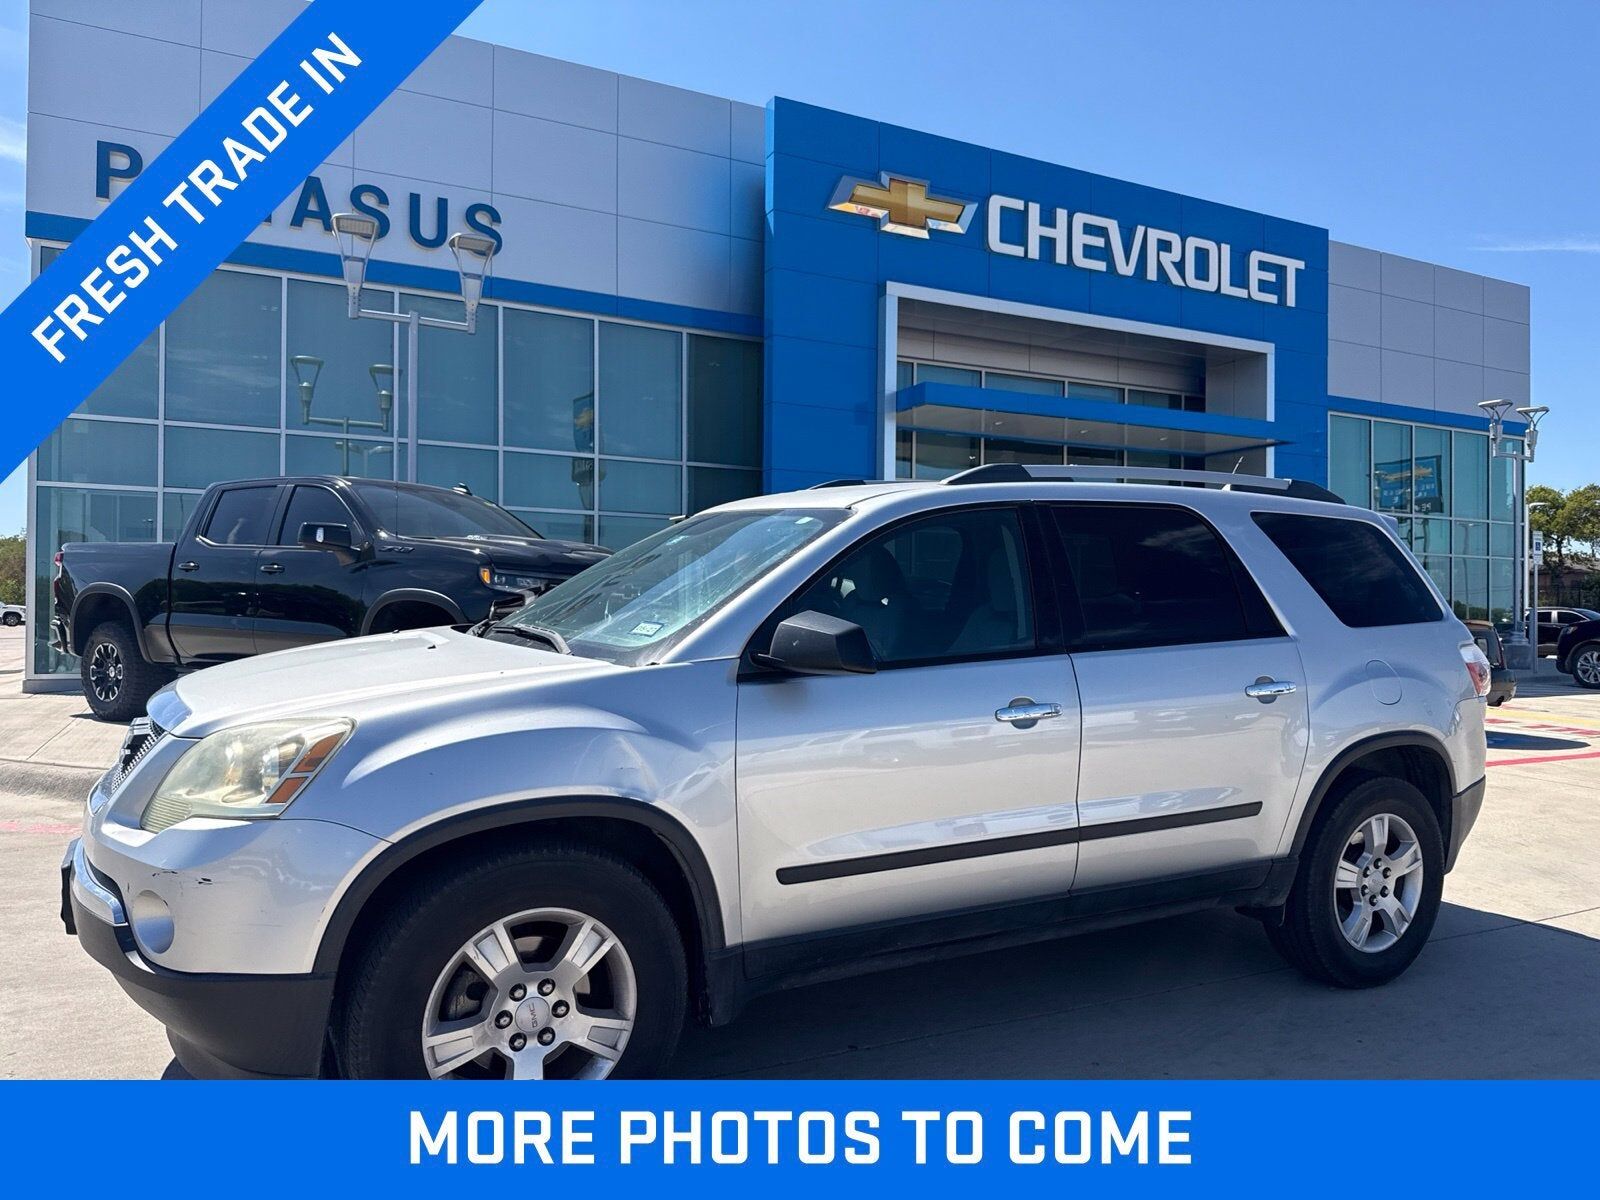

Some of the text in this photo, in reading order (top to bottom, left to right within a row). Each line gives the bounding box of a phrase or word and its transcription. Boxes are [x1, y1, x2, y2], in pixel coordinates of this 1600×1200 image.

[95, 139, 503, 257] PASUS
[986, 193, 1306, 308] CHEVROLET
[528, 1003, 538, 1028] GMC
